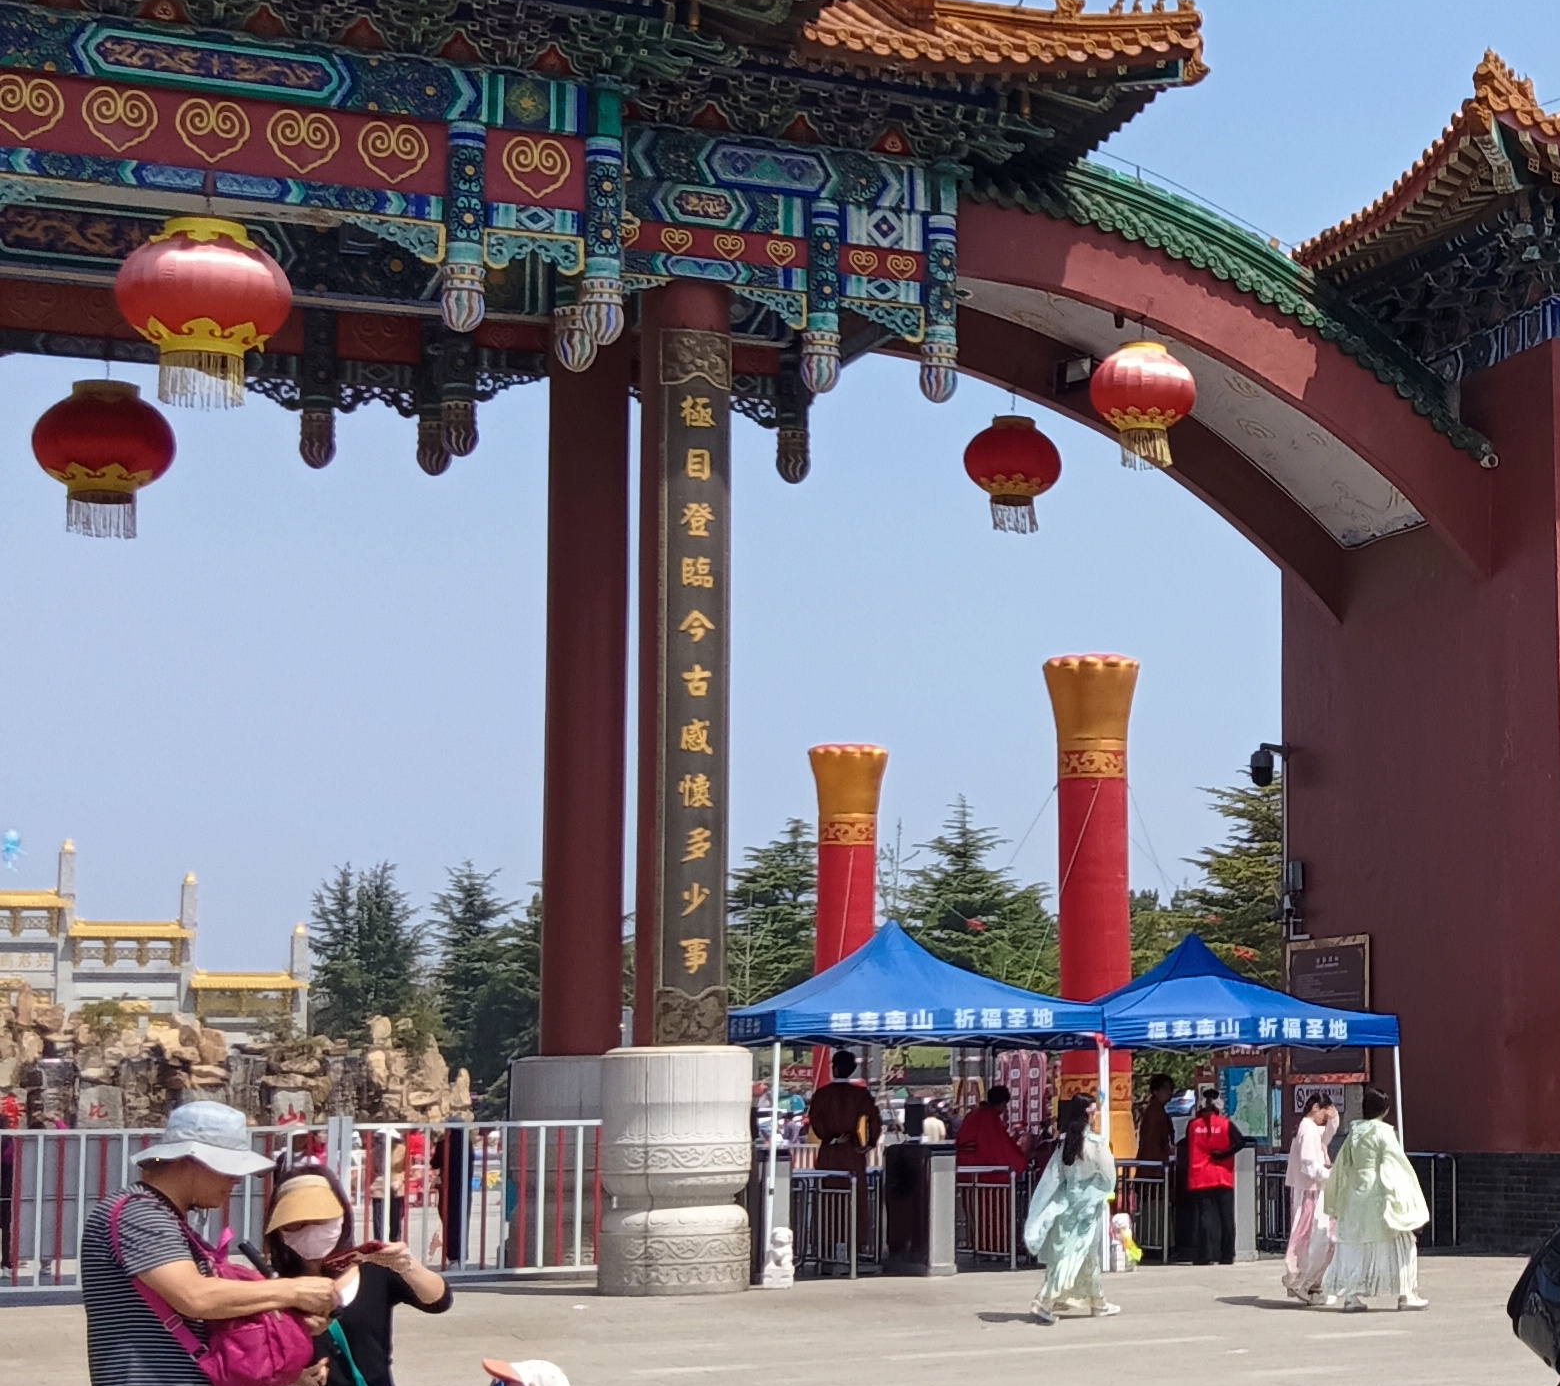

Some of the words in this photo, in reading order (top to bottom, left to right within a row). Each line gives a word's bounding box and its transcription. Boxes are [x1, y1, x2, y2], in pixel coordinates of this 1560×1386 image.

[830, 1008, 934, 1032] 福寿南山
[954, 1007, 1055, 1030] 祈福圣地
[1147, 1017, 1240, 1041] 福寿南山
[1258, 1016, 1349, 1040] 祈福圣地
